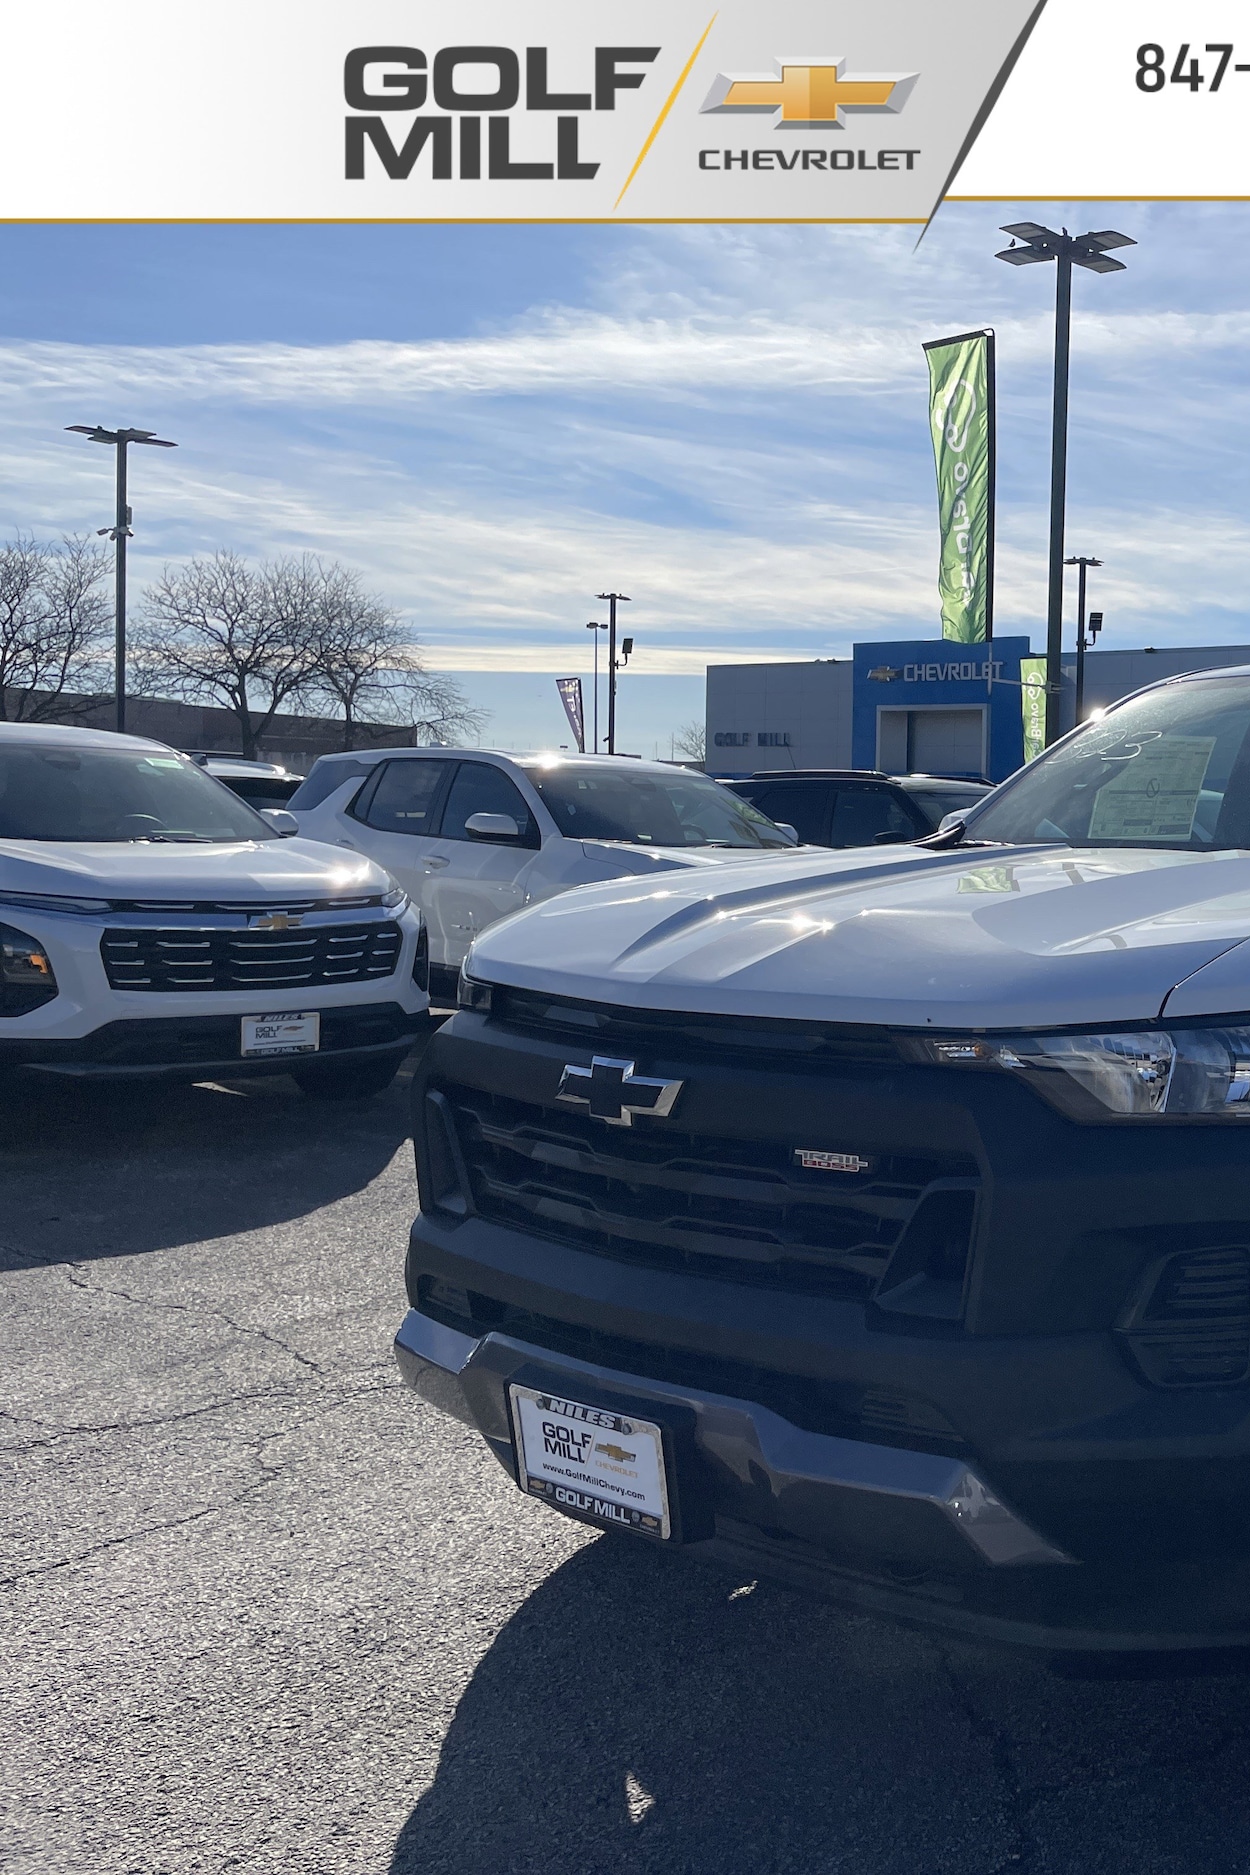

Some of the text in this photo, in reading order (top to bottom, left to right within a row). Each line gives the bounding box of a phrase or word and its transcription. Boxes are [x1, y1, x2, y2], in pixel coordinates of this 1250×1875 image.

[903, 661, 1004, 682] CHEVROLET
[794, 1149, 869, 1167] TRAIL
[549, 1399, 616, 1429] NILES
[542, 1421, 592, 1448] GOLF
[544, 1437, 586, 1464] MILL
[542, 1462, 646, 1501] www.GolfMillChevy.com
[595, 1460, 639, 1478] CHEVROLET
[555, 1487, 631, 1524] GOLF MILL
